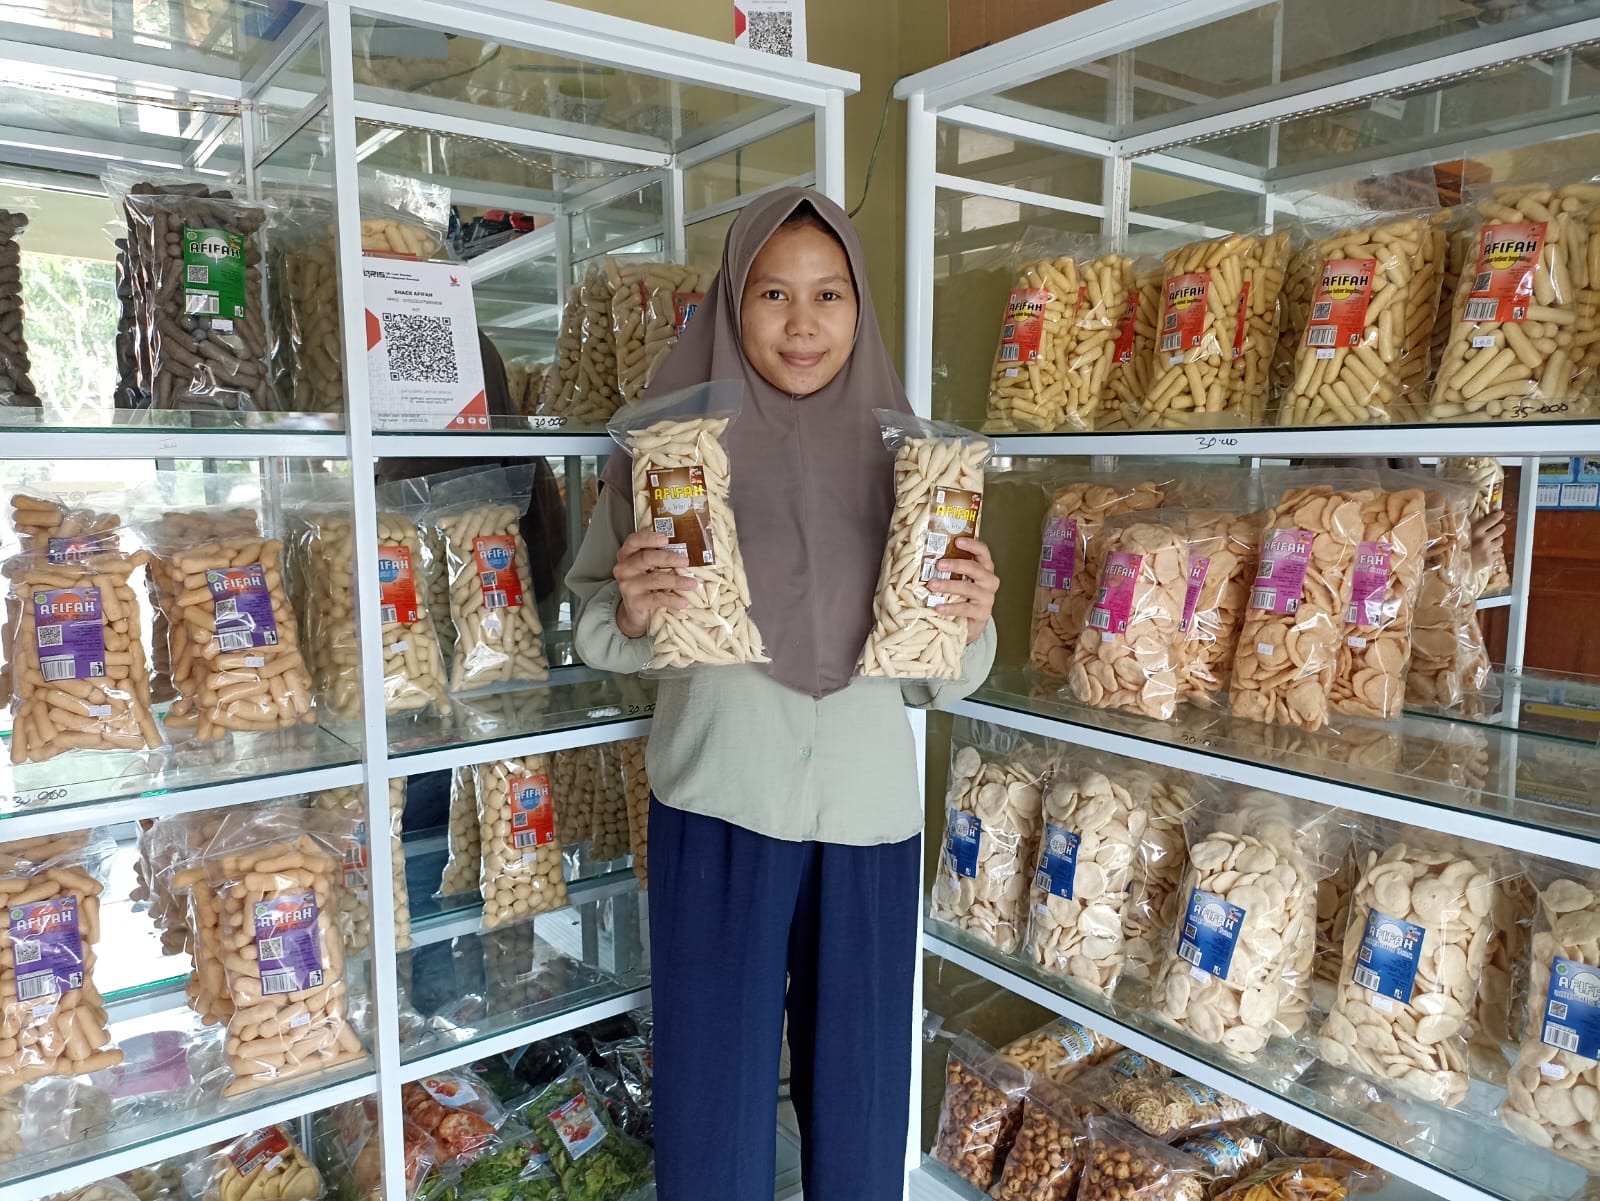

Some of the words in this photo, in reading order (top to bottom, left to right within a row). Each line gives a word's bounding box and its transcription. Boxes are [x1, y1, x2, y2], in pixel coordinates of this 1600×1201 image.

[189, 242, 241, 258] AFIFAH
[1484, 241, 1537, 255] AFIFAH
[1322, 276, 1369, 286] AFIFAH
[1169, 286, 1205, 300] AFIFAH
[1009, 301, 1043, 311] AFIFAH
[655, 485, 704, 500] AFIFAH
[936, 505, 977, 521] AFIFAH
[480, 549, 515, 560] AFIFAH
[1264, 542, 1305, 553] AFIFAH
[380, 559, 409, 570] IFAH
[1359, 554, 1385, 565] FAH
[214, 577, 261, 591] AFIFAH
[40, 601, 95, 615] AFIFAH
[515, 787, 549, 800] AFIFAH
[1194, 904, 1235, 931] AFIFAH
[1370, 926, 1414, 951] AFIFAH
[1559, 976, 1600, 999] AFIFA
